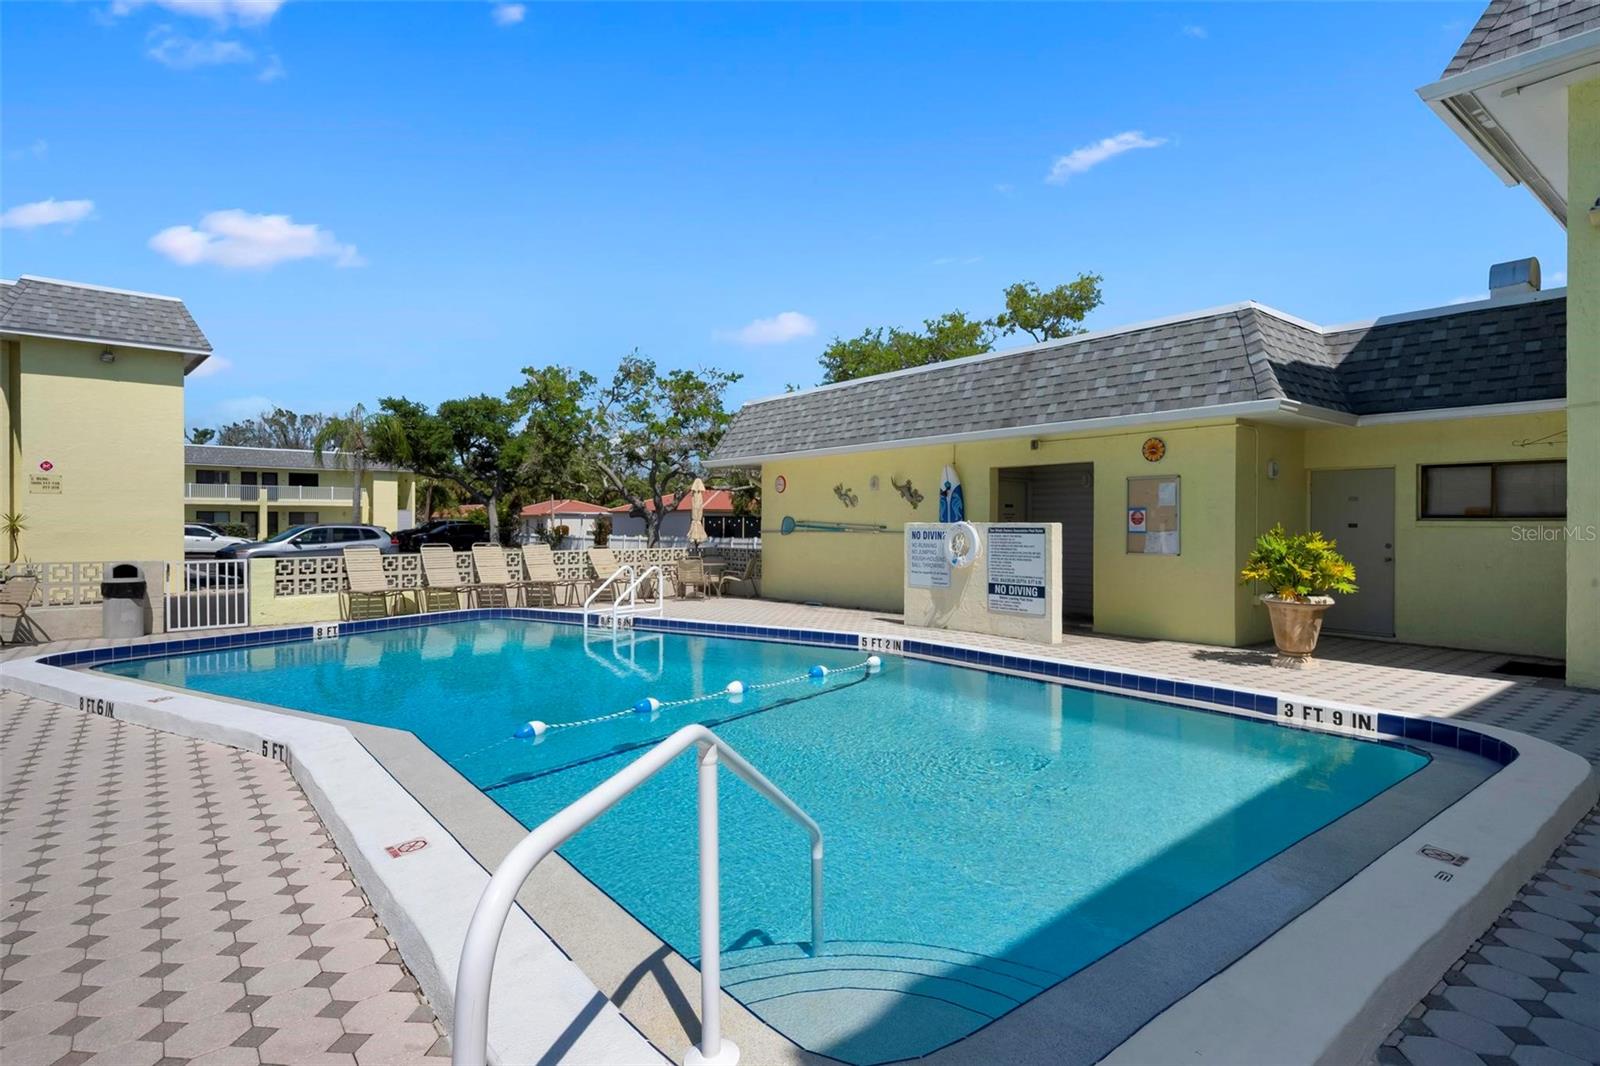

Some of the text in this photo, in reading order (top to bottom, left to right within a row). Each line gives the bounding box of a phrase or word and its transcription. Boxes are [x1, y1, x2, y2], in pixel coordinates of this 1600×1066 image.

[911, 531, 921, 540] NO
[994, 584, 1038, 597] NO DIVING
[317, 627, 323, 637] 8
[862, 637, 867, 647] 5
[885, 639, 891, 650] 2
[893, 640, 902, 651] IN
[79, 697, 84, 711] 8
[97, 698, 104, 716] 6
[1284, 703, 1375, 732] 3 FT. 9 IN.
[262, 740, 268, 757] 5
